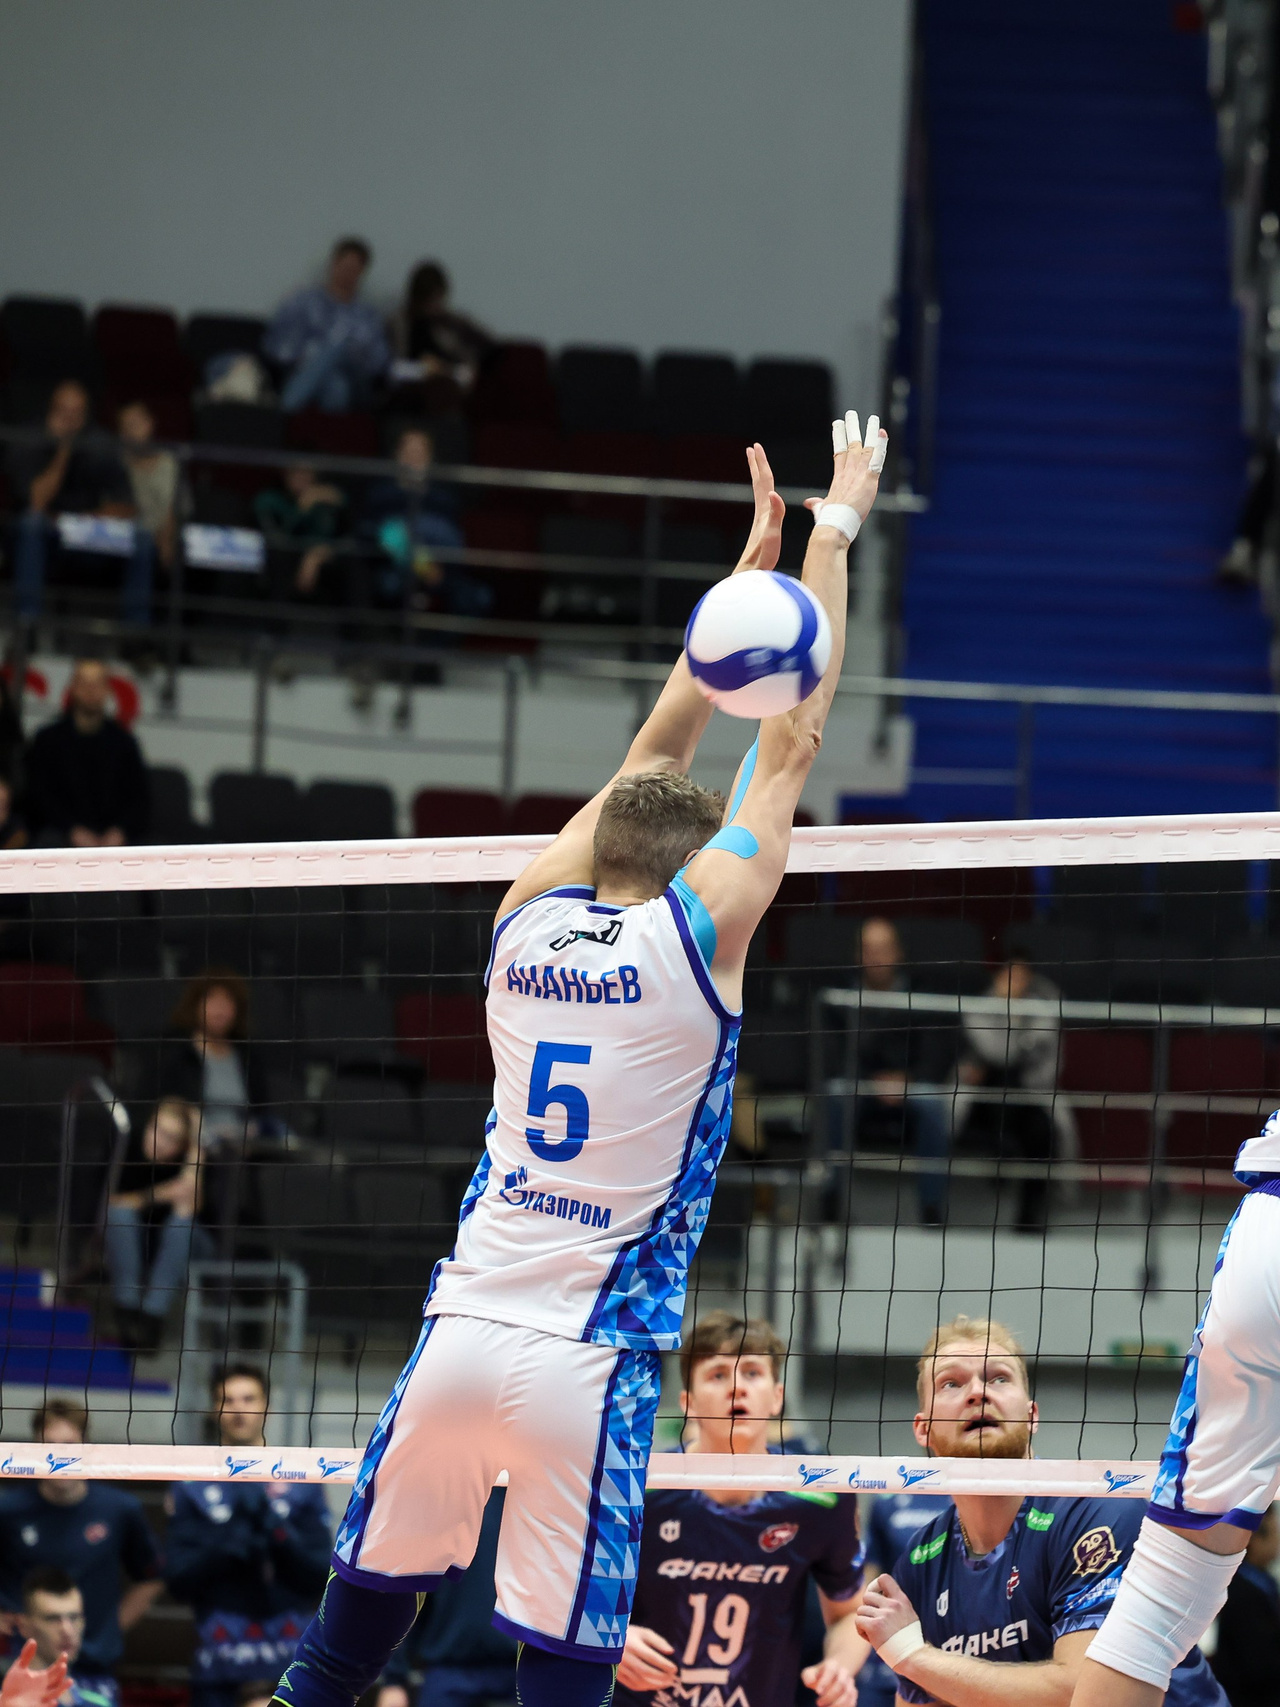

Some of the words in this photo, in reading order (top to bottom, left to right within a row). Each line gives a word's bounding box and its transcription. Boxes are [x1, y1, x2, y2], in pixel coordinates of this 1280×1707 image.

[507, 959, 642, 1004] АНАНЬЕВ
[526, 1041, 592, 1162] 5
[525, 1190, 612, 1229] ГАЗПРОМ
[1081, 1533, 1103, 1553] 20
[657, 1558, 790, 1584] ФАКЕЛ
[682, 1593, 750, 1666] 19
